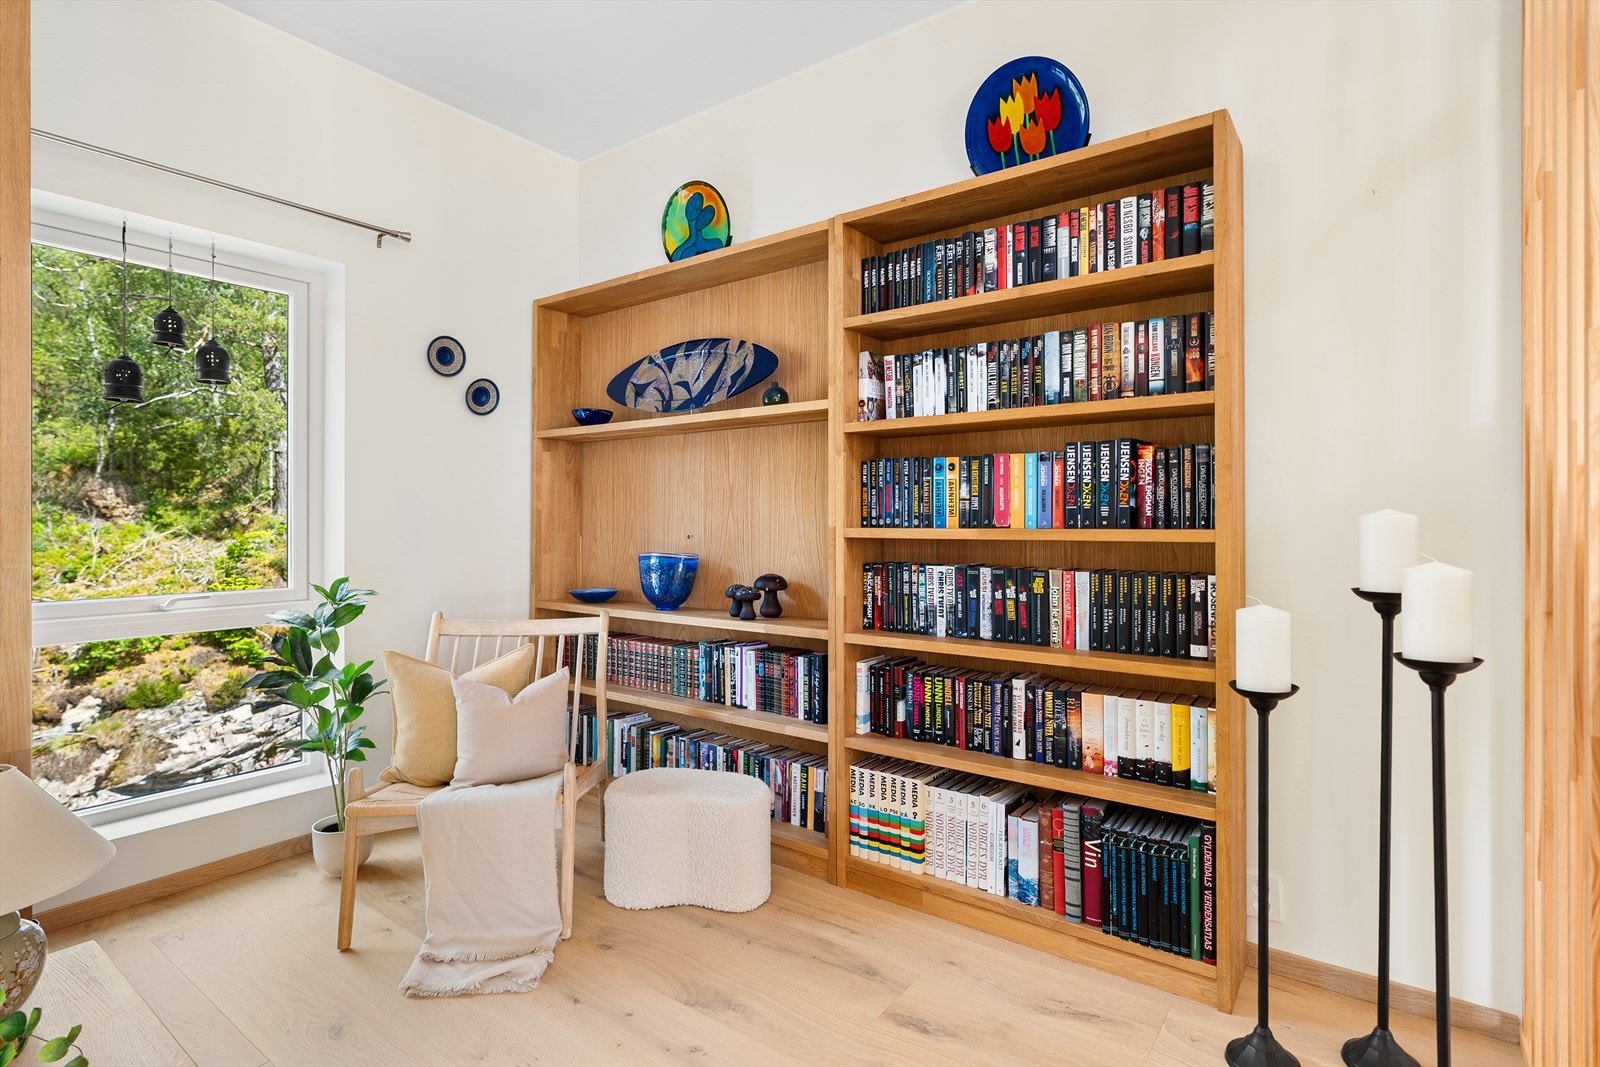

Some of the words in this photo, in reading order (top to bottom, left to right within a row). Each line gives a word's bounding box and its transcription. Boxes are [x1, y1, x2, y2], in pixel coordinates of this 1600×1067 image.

[1123, 200, 1133, 209] JO
[1107, 206, 1116, 239] MACBETH
[1123, 210, 1133, 233] NESBØ
[1107, 239, 1116, 249] JO
[1123, 236, 1133, 265] SØNNEN
[1107, 250, 1116, 271] NESBØ
[1104, 324, 1114, 334] DAN
[1062, 343, 1072, 354] DAN
[1074, 334, 1086, 350] DAN
[1104, 334, 1114, 354] BROWN
[1062, 354, 1072, 373] BROWN
[1074, 352, 1086, 380] BROWN
[1151, 353, 1160, 378] KONGEN
[988, 362, 997, 405] NULLPUNKT
[1067, 448, 1076, 483] JENSEN
[1083, 447, 1092, 483] JENSEN
[1101, 446, 1109, 482] JENSEN
[1120, 445, 1130, 481] JENSEN
[1051, 586, 1060, 606] John
[1052, 609, 1060, 618] le
[1052, 619, 1061, 644] Carré
[934, 676, 943, 703] UNNI
[973, 682, 982, 708] DANIELLE
[974, 709, 982, 725] STEEL
[1044, 691, 1053, 718] DANIELLE
[1066, 697, 1075, 728] RILEY
[1045, 719, 1054, 736] STEEL
[925, 810, 934, 847] NORGES
[935, 812, 944, 848] NORGES
[947, 816, 955, 852] NORGES
[956, 819, 964, 854] NORGES
[968, 821, 977, 858] NORGES
[979, 821, 988, 858] NORGES
[925, 847, 934, 867] DYR
[935, 850, 944, 870] DYR
[947, 854, 955, 873] DYR
[1084, 839, 1101, 869] Vin
[1203, 834, 1212, 887] GYLDENDALS
[956, 857, 964, 877] DYR
[968, 860, 977, 880] DYR
[979, 861, 988, 881] DYR
[1203, 890, 1212, 951] VERDENSATLAS
